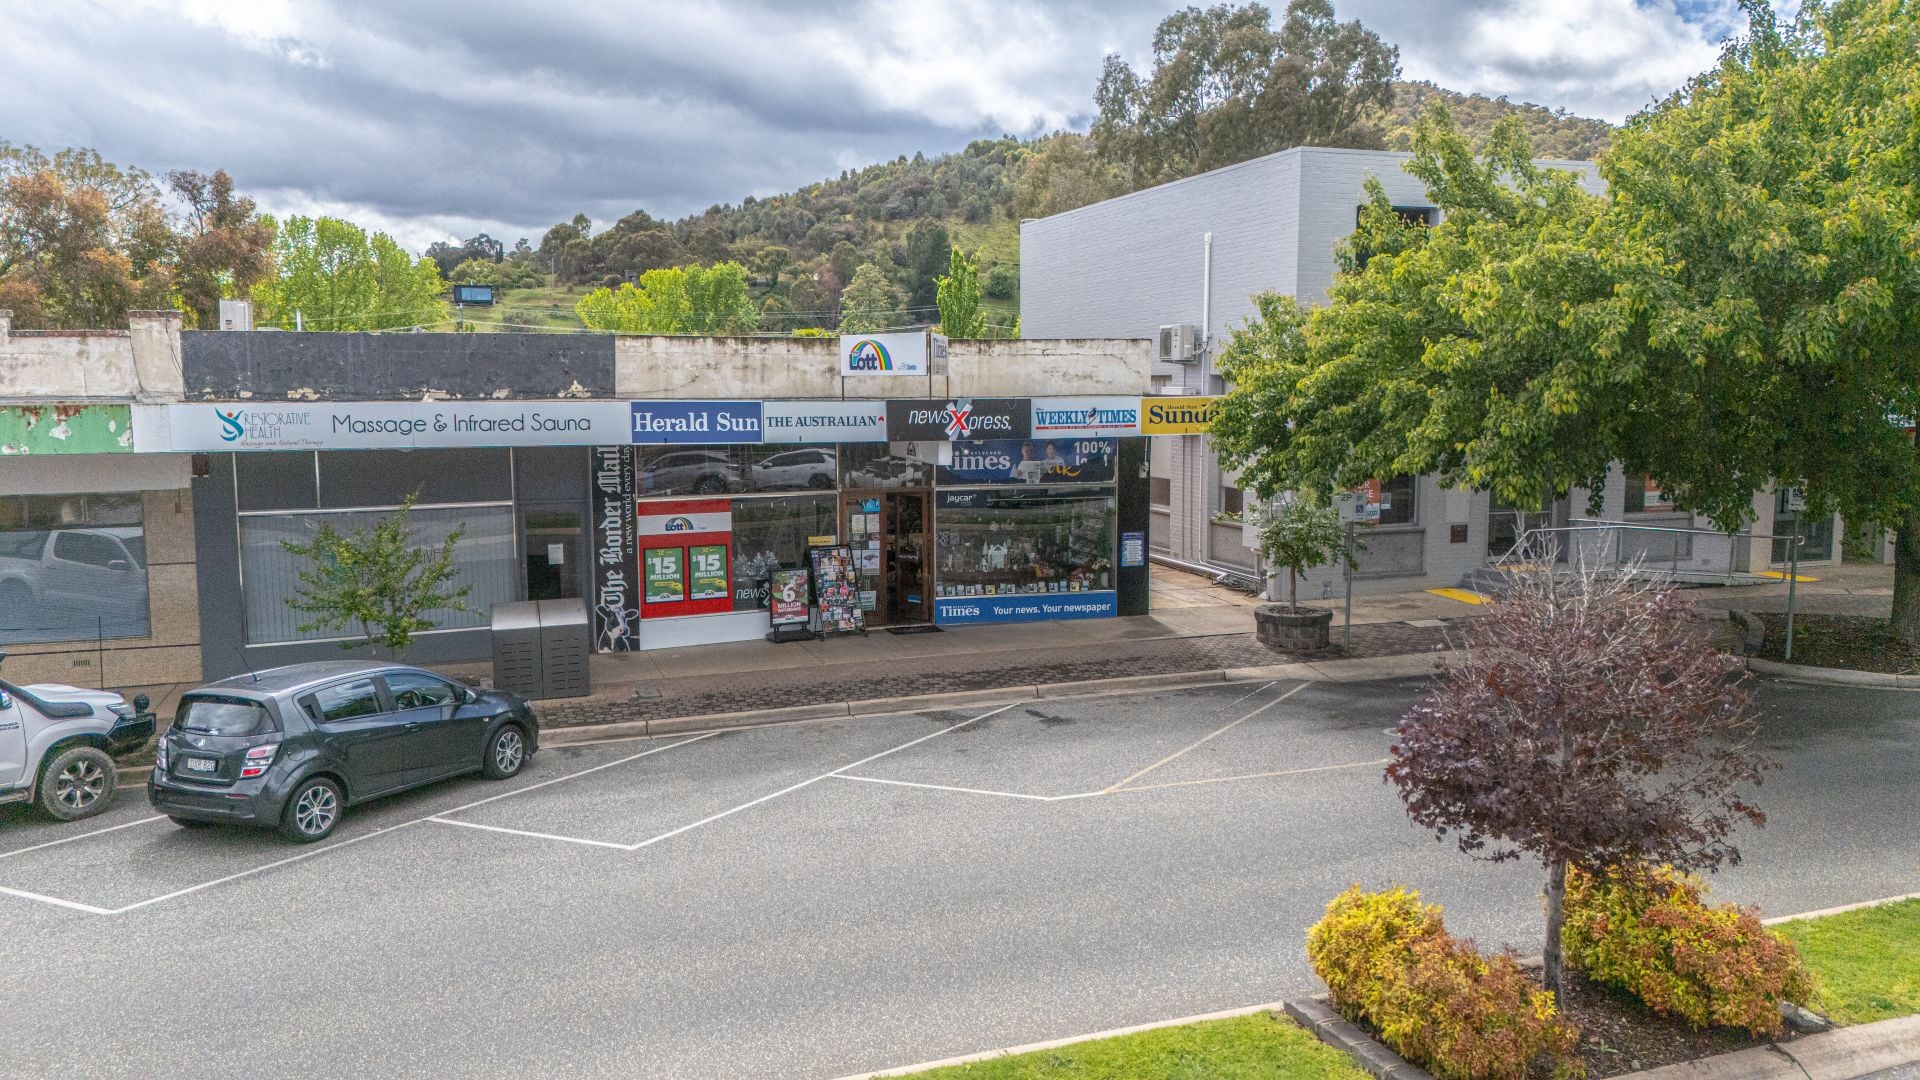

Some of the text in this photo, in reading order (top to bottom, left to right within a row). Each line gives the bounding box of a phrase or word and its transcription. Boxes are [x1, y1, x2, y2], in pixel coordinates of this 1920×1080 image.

[244, 412, 311, 426] RESTORATIVE
[766, 415, 877, 428] THE AUSTRALIAN
[1036, 409, 1137, 425] WEEKLY TIMES
[1149, 403, 1220, 425] Sunda
[332, 413, 592, 436] Massage & Infrared Sauna
[633, 412, 760, 432] Herald Sun
[245, 426, 281, 440] HEALTH
[621, 445, 633, 464] day
[1074, 441, 1111, 454] 100%
[952, 451, 1012, 471] imes
[623, 466, 634, 493] every
[946, 493, 973, 504] jaycar
[1341, 493, 1353, 502] 2P
[622, 494, 633, 528] world
[597, 445, 628, 611] The Border Mail
[625, 530, 633, 546] new
[650, 573, 680, 581] MILLION
[694, 570, 724, 578] MILLION
[940, 605, 980, 617] Times
[993, 603, 1112, 615] Your news. Your newspaper
